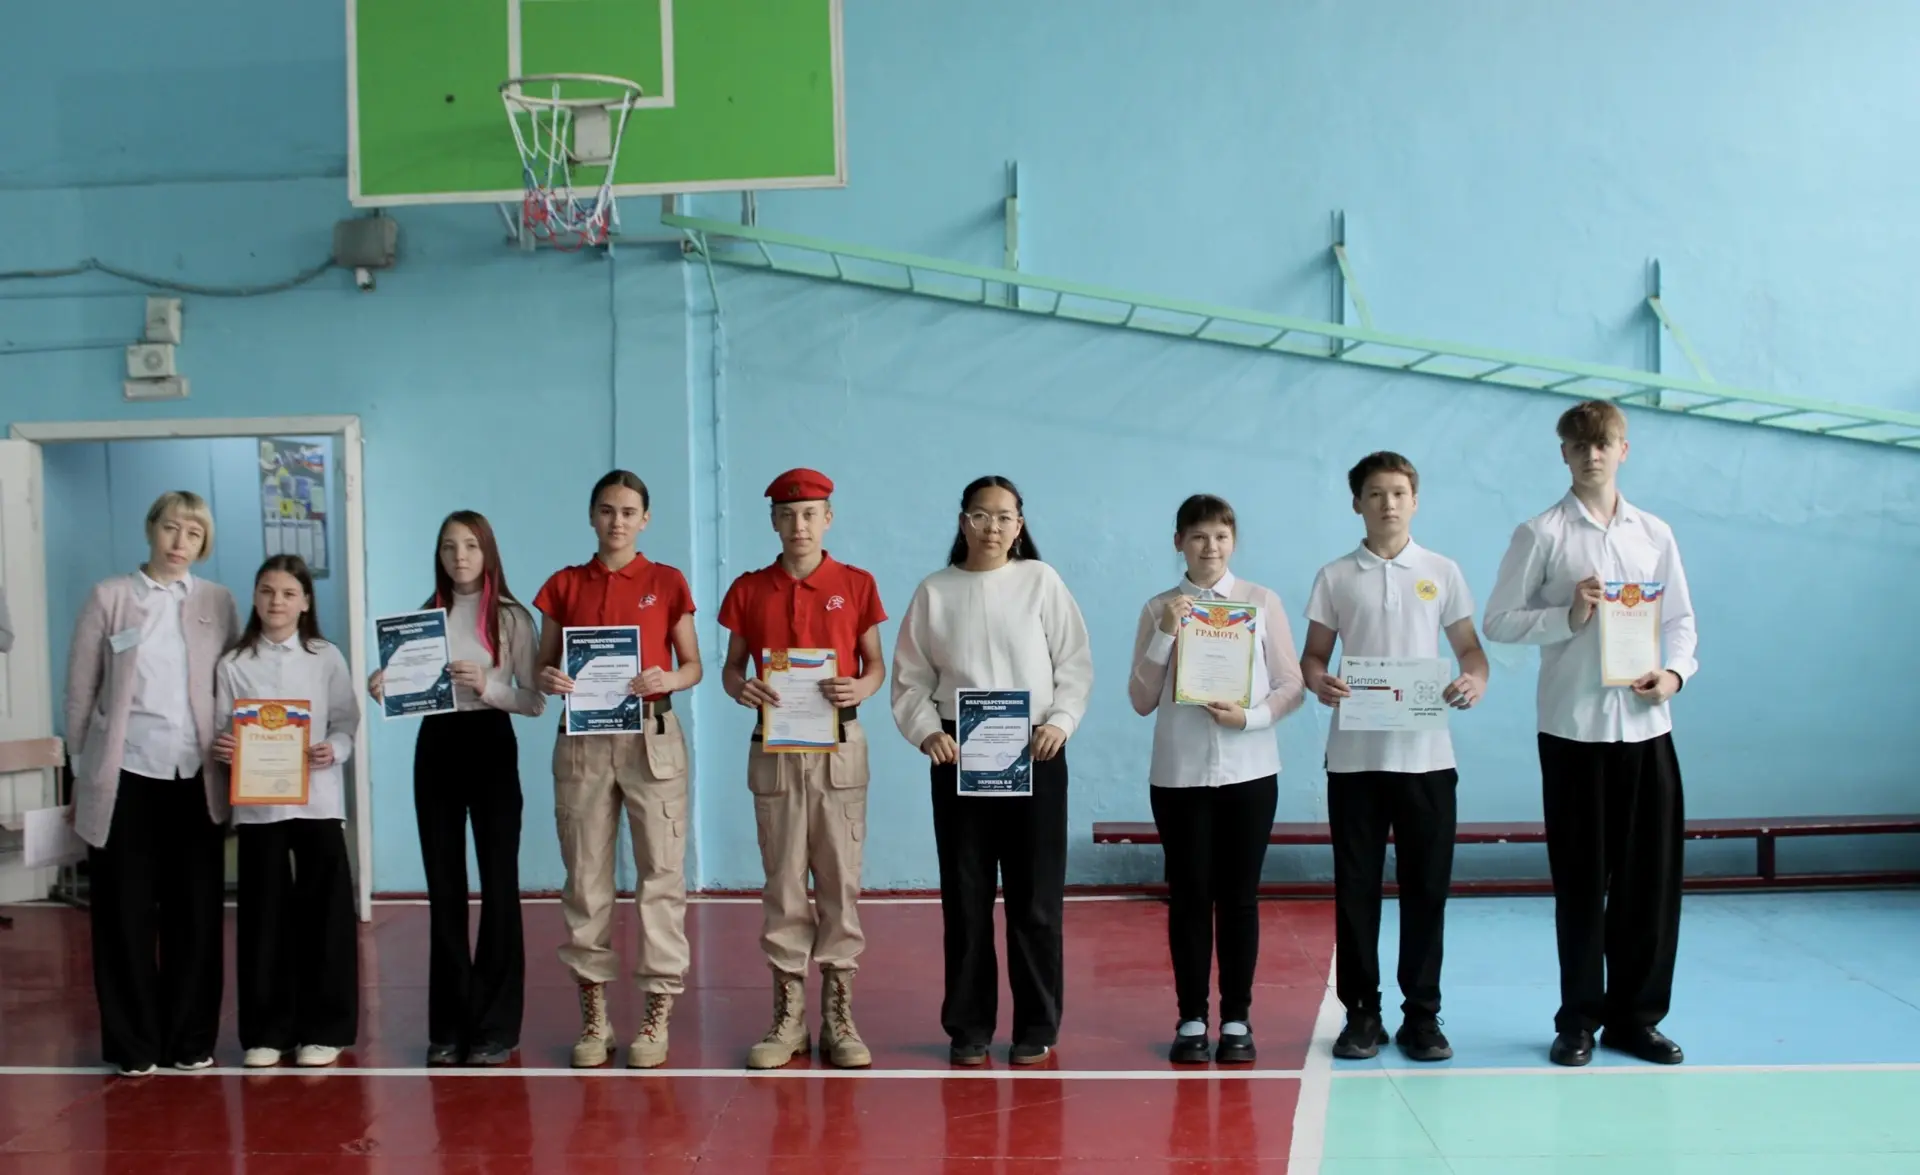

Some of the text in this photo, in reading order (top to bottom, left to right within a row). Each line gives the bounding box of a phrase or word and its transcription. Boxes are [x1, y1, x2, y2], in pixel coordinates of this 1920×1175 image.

[1195, 628, 1239, 640] ГРАМОТА
[572, 637, 633, 645] БЛАГОДАРСТВЕННОЕ
[1346, 675, 1388, 685] Диплом
[249, 732, 295, 741] ГРАМОТА
